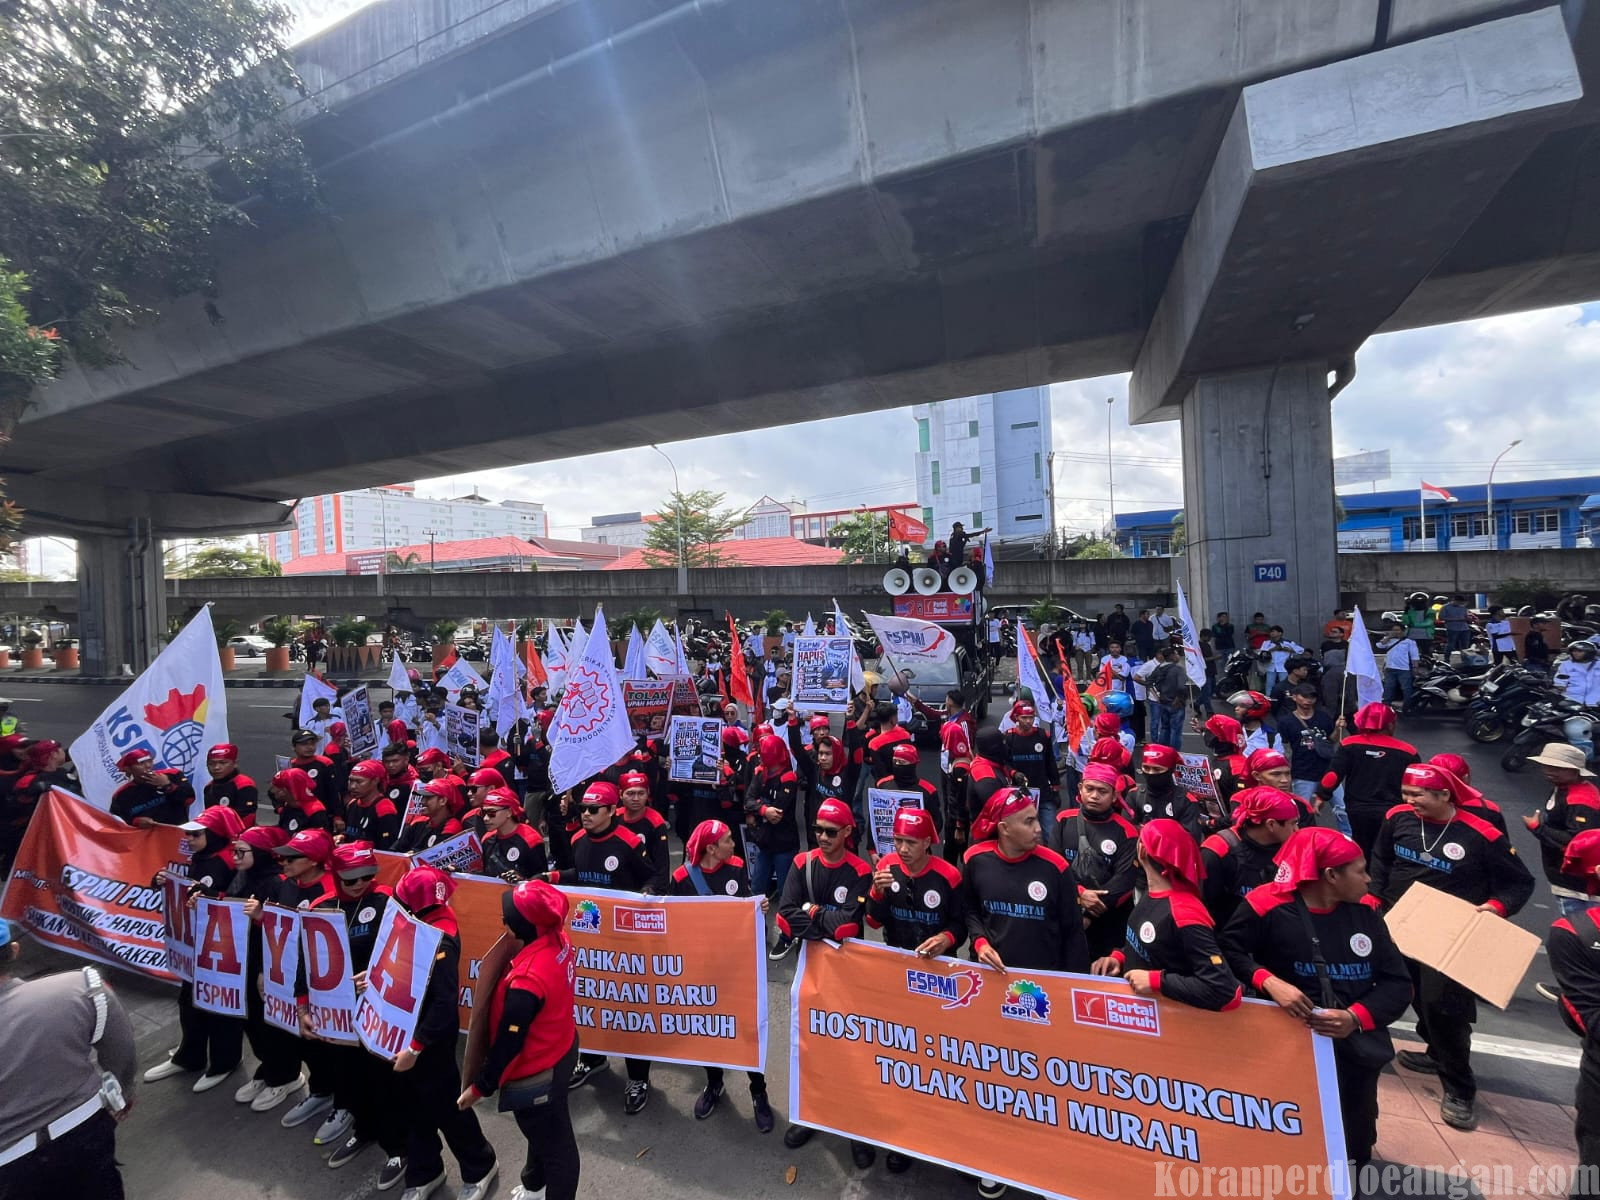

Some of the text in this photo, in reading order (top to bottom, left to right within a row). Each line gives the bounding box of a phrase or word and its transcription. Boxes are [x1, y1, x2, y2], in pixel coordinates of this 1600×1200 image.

[1258, 566, 1282, 579] P40
[884, 629, 926, 646] FSPMI
[797, 650, 825, 660] HAPUS
[797, 659, 825, 667] PAJAK
[627, 691, 669, 700] TOLAK
[675, 731, 700, 739] BURUH
[61, 864, 123, 902] FSPMI
[634, 912, 664, 922] Partai
[1014, 903, 1046, 916] METAL
[111, 917, 155, 941] HAPUS
[634, 920, 664, 929] Buruh
[197, 903, 242, 976] A
[262, 911, 294, 986] Y
[302, 916, 346, 992] D
[368, 911, 418, 1014] A
[651, 954, 683, 977] UU
[906, 969, 958, 997] FSPMI
[196, 981, 241, 1011] FSPMI
[654, 983, 718, 1007] BARU
[1001, 1004, 1033, 1018] KSPI
[1107, 999, 1154, 1018] Partai
[355, 999, 407, 1054] FSPMI
[600, 1007, 656, 1034] PADA
[660, 1013, 736, 1039] BURUH
[1108, 1012, 1157, 1030] Buruh
[808, 1008, 918, 1054] HOSTUM
[939, 1037, 1040, 1081] HAPUS
[1045, 1056, 1303, 1136] OUTSOURCING
[875, 1055, 1201, 1163] TOLAK UPAH MURAH
